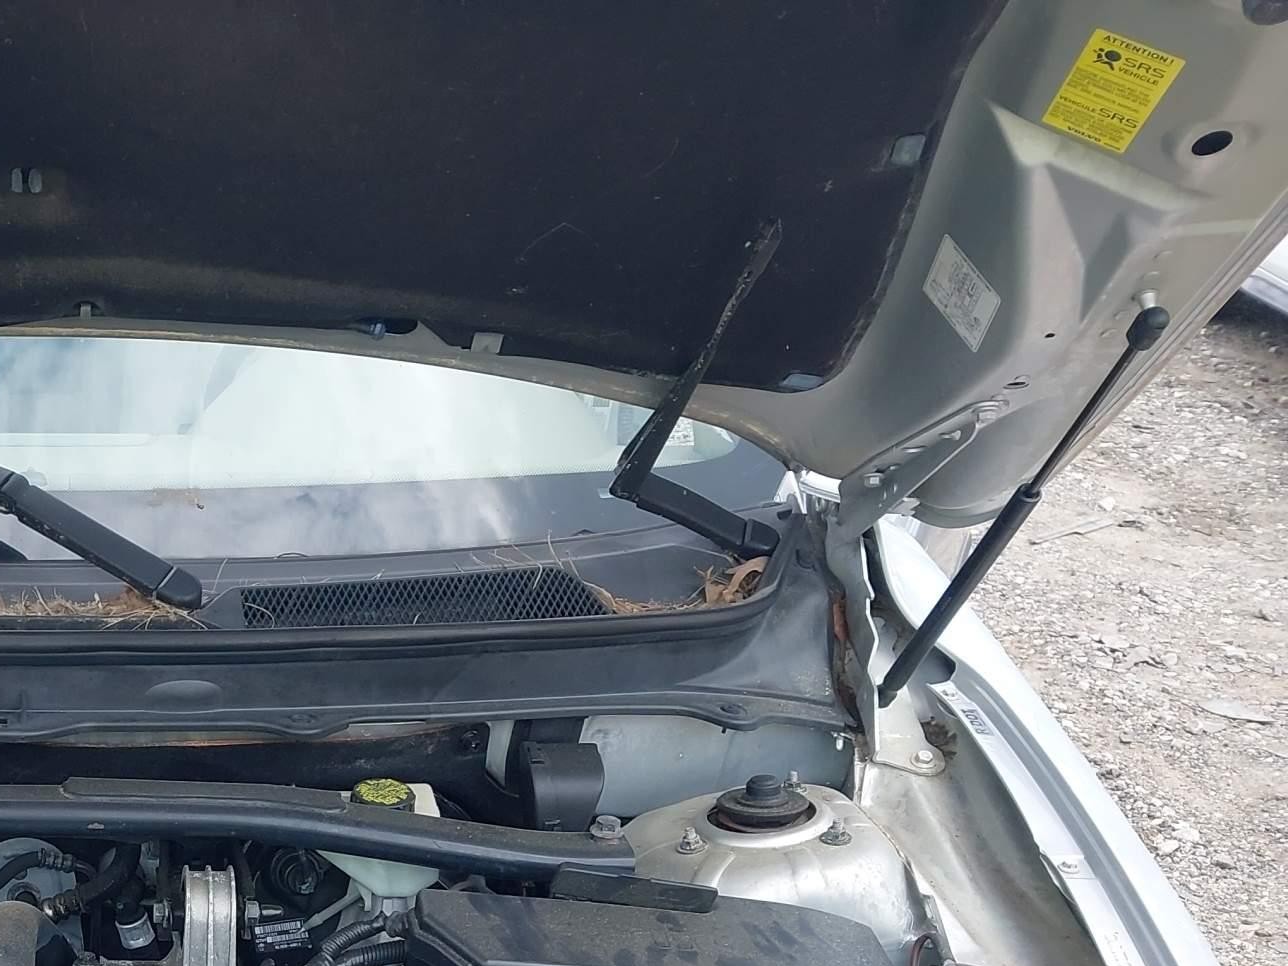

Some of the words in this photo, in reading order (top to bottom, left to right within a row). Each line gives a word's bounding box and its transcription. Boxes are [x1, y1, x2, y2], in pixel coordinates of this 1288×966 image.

[1103, 35, 1168, 64] ATTENTION
[1118, 66, 1159, 85] VEHICLE
[1121, 57, 1167, 79] SRS
[1059, 95, 1097, 114] VEHICULE
[1099, 106, 1139, 129] SRS
